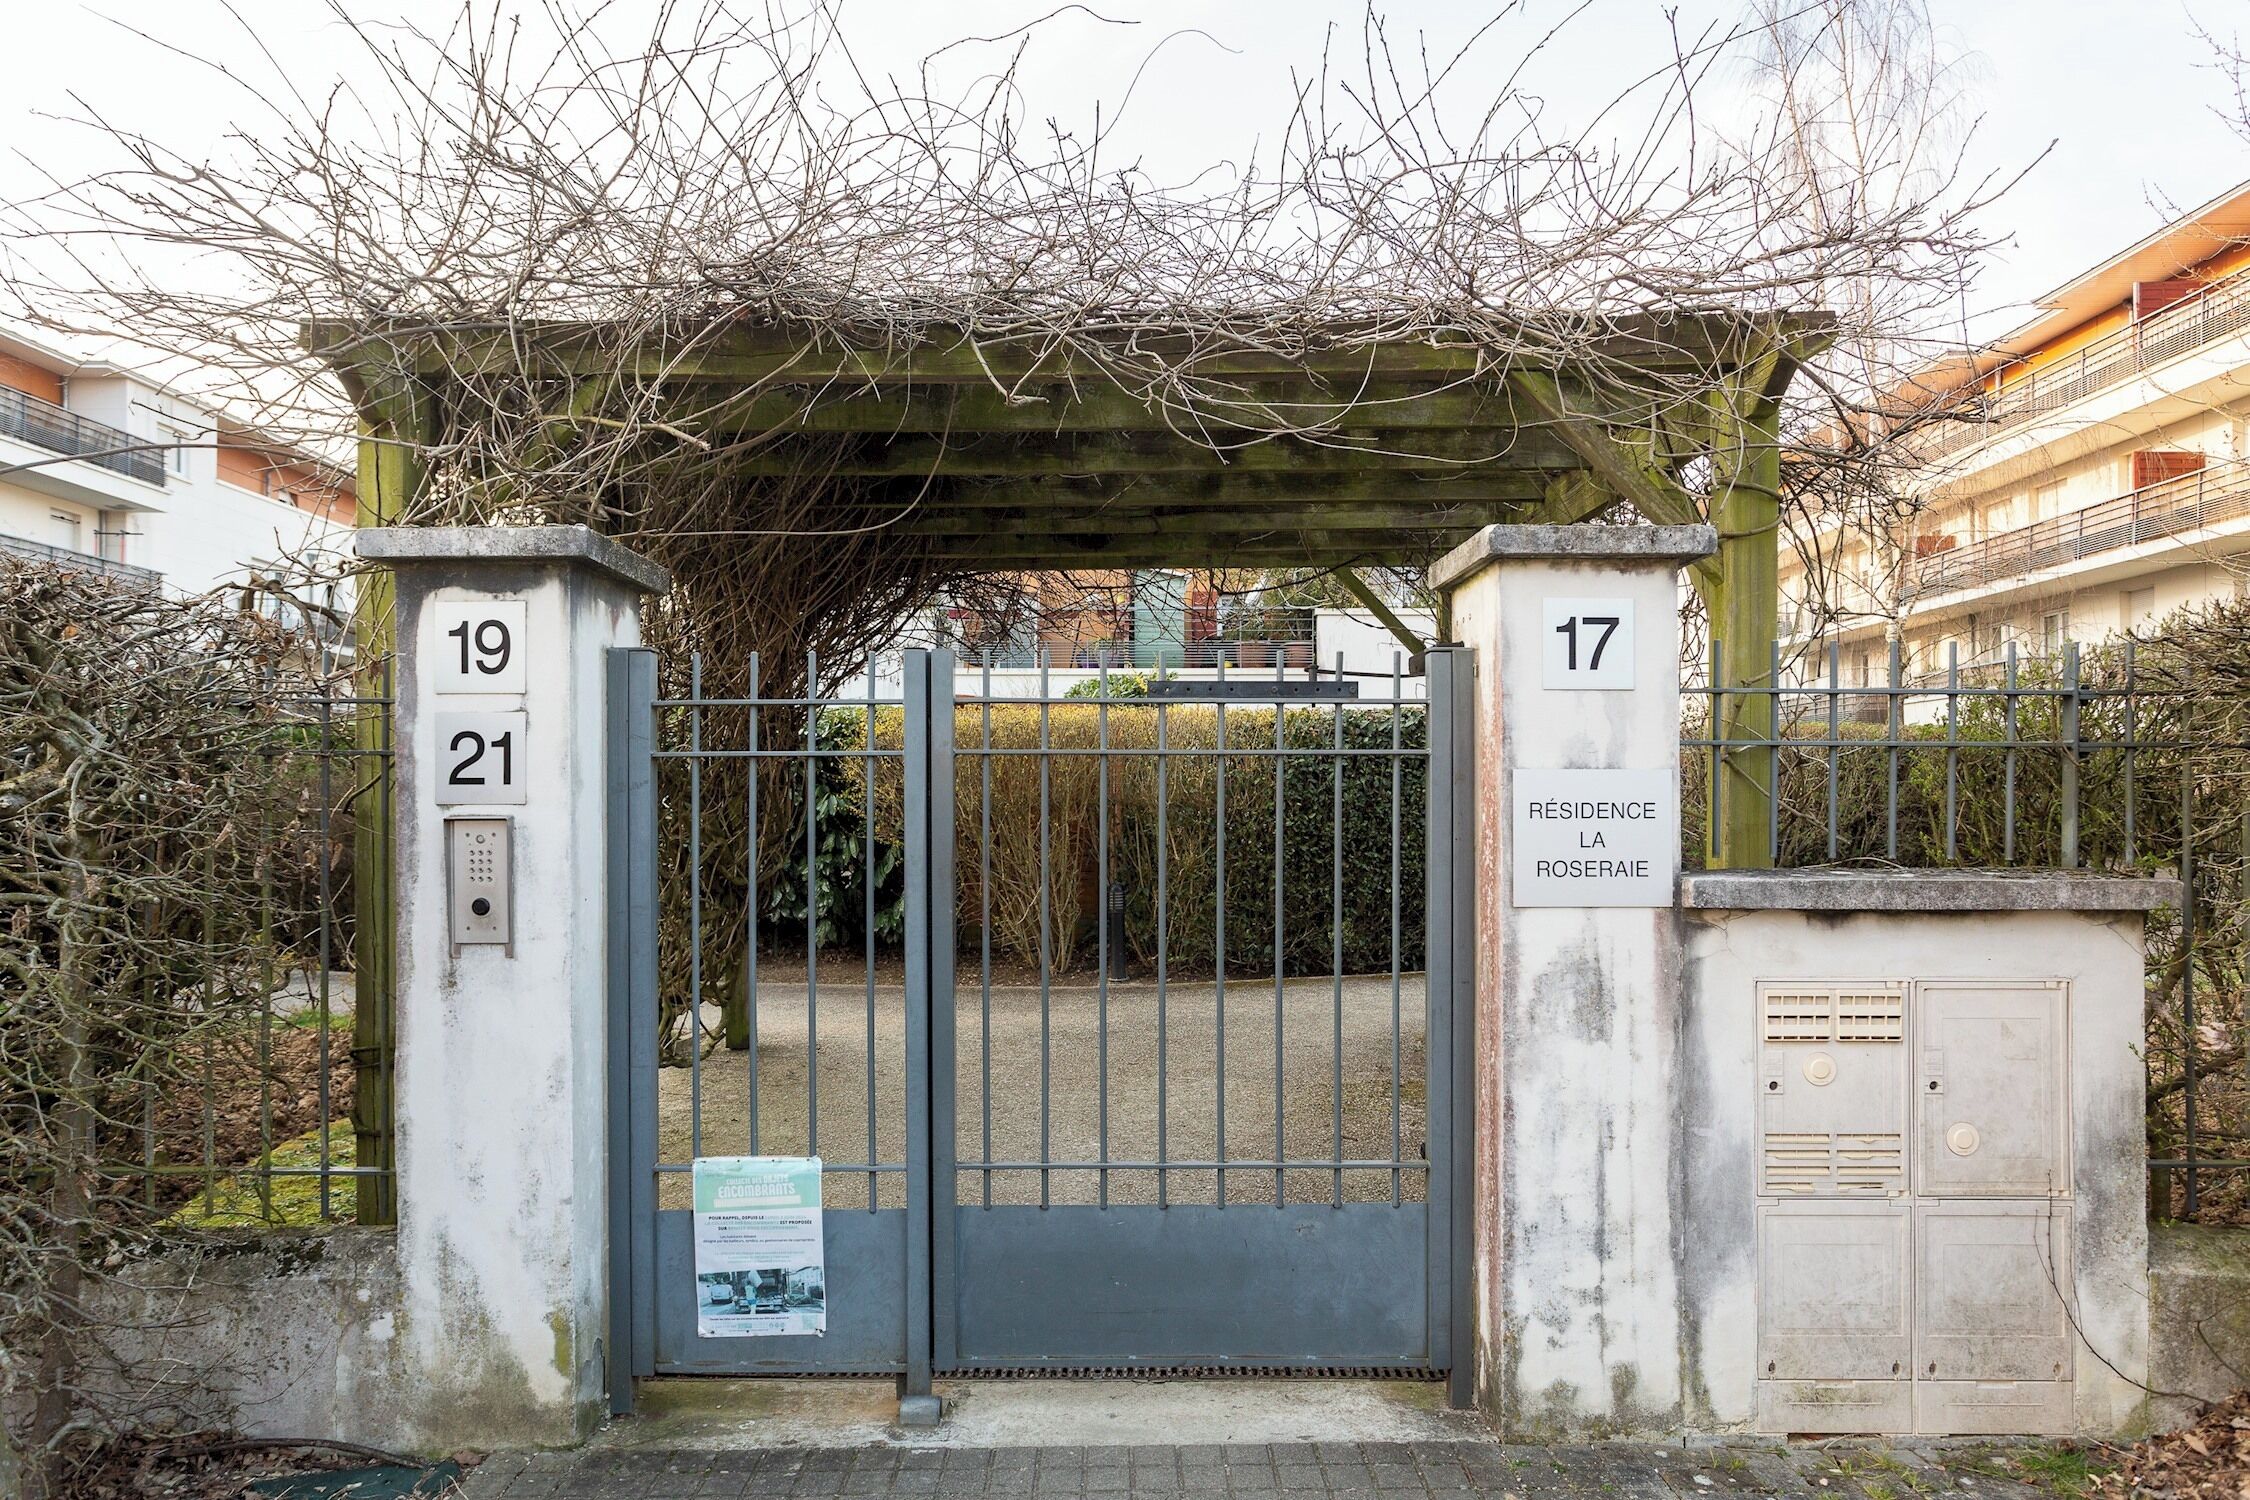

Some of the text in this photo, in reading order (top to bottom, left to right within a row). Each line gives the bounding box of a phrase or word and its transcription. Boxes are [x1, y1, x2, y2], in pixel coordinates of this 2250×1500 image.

[448, 619, 511, 675] 19
[1556, 616, 1620, 671] 17
[448, 730, 512, 786] 21
[1529, 798, 1656, 819] RÉSIDENCE
[1579, 832, 1606, 848] LA
[1536, 861, 1649, 877] ROSERAIE
[718, 1182, 796, 1199] ENCOMBRANTS
